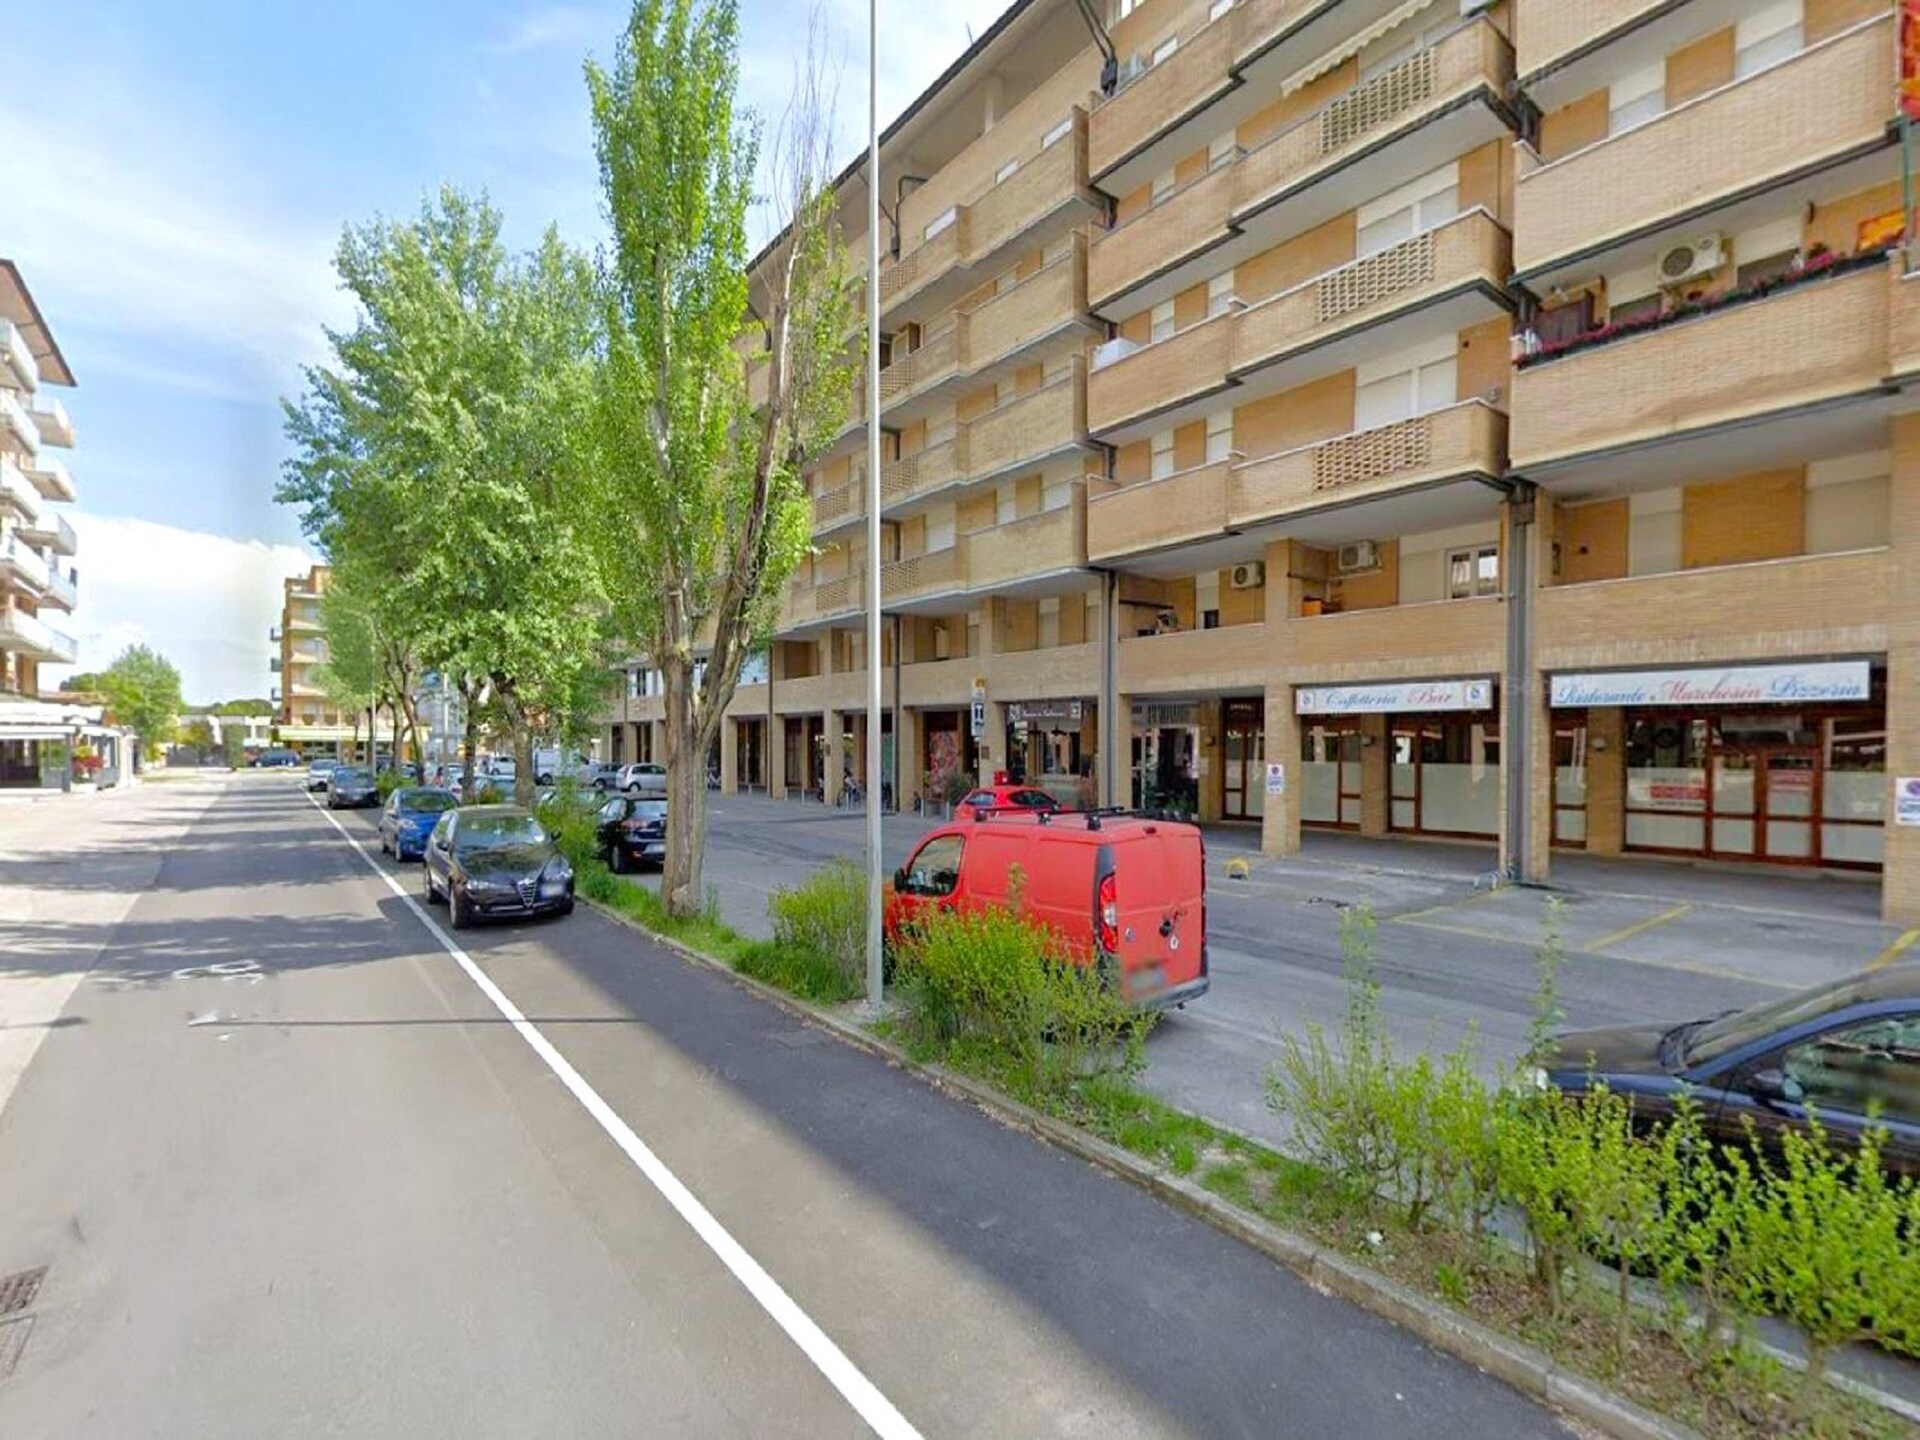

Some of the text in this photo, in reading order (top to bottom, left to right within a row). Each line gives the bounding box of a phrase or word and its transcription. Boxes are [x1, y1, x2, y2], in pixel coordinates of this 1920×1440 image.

[1324, 686, 1453, 709] Caffetteria Bar
[1555, 682, 1645, 703] Ristorante
[1767, 674, 1862, 698] Pizzeria
